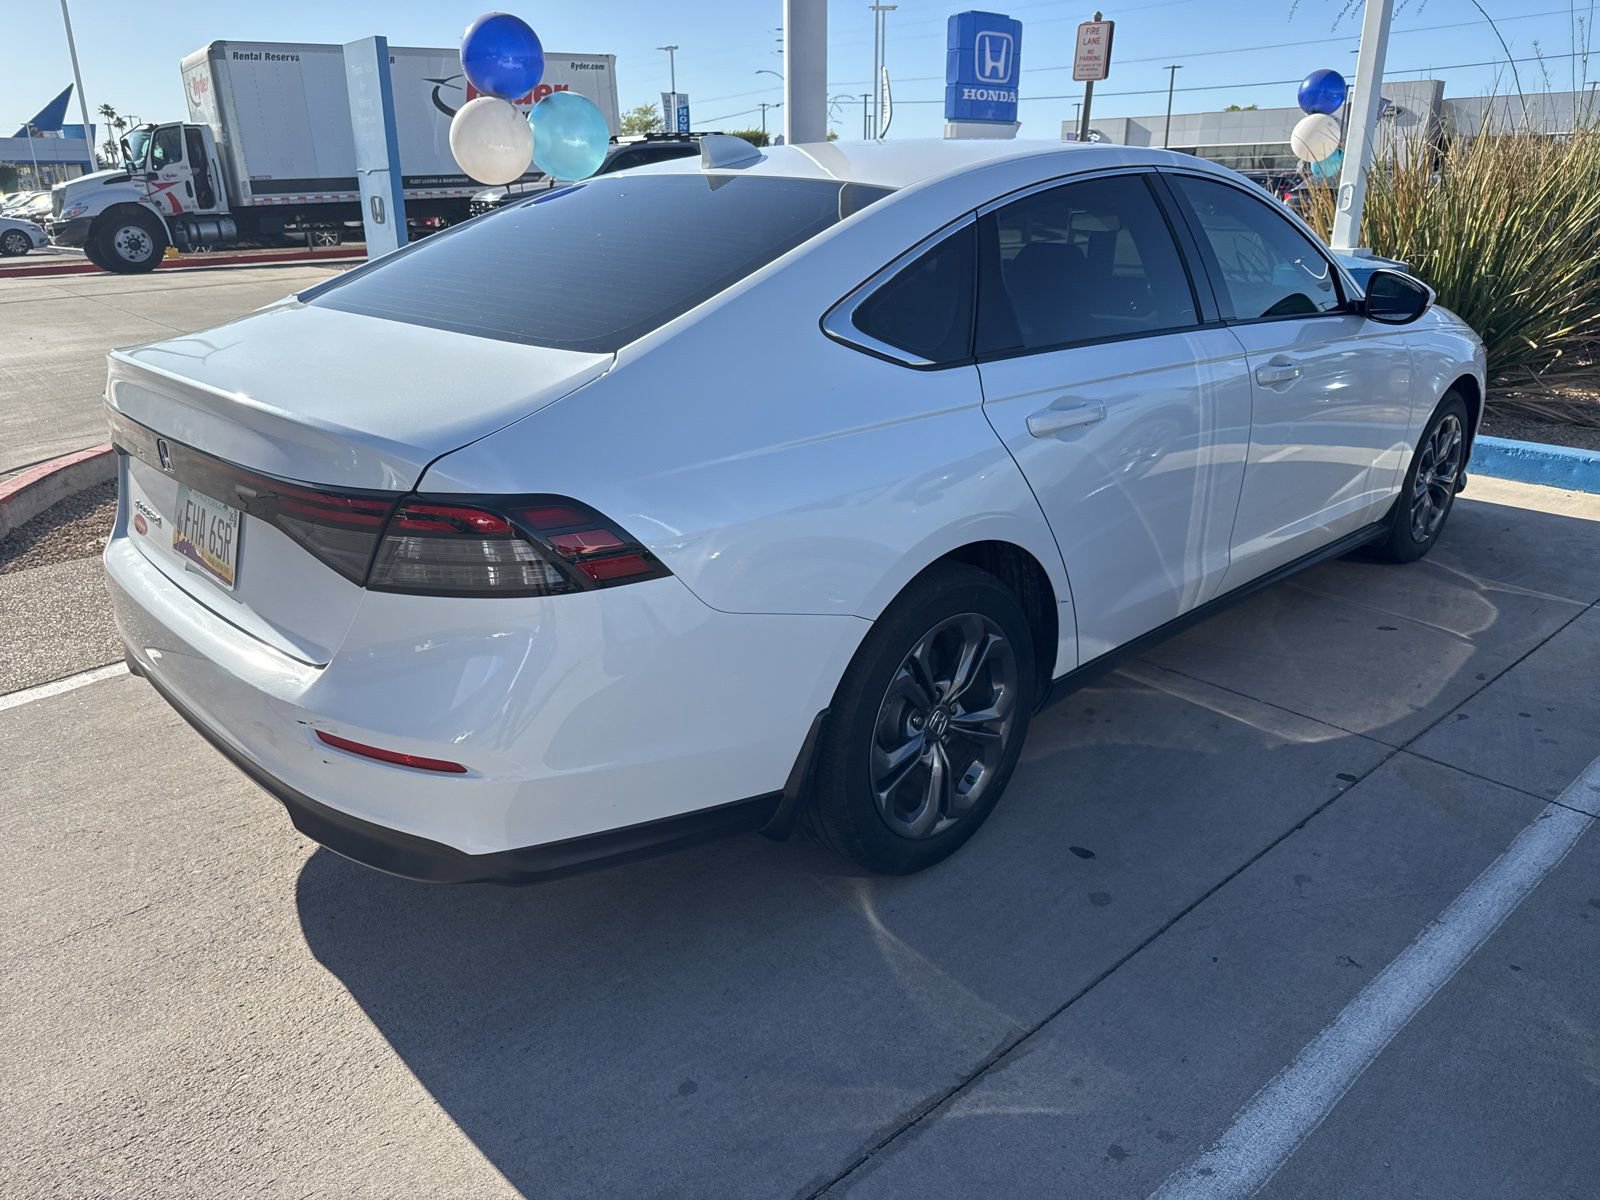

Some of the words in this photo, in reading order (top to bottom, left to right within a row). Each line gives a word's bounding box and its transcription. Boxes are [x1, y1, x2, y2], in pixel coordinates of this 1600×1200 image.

[1085, 26, 1101, 35] FIRE
[1082, 36, 1101, 46] LANE
[232, 51, 262, 61] Rental
[570, 62, 605, 71] Ryder.com
[962, 88, 1017, 103] HONDA
[679, 108, 688, 132] HON
[184, 499, 206, 549] FHA
[209, 515, 232, 565] 6SR
